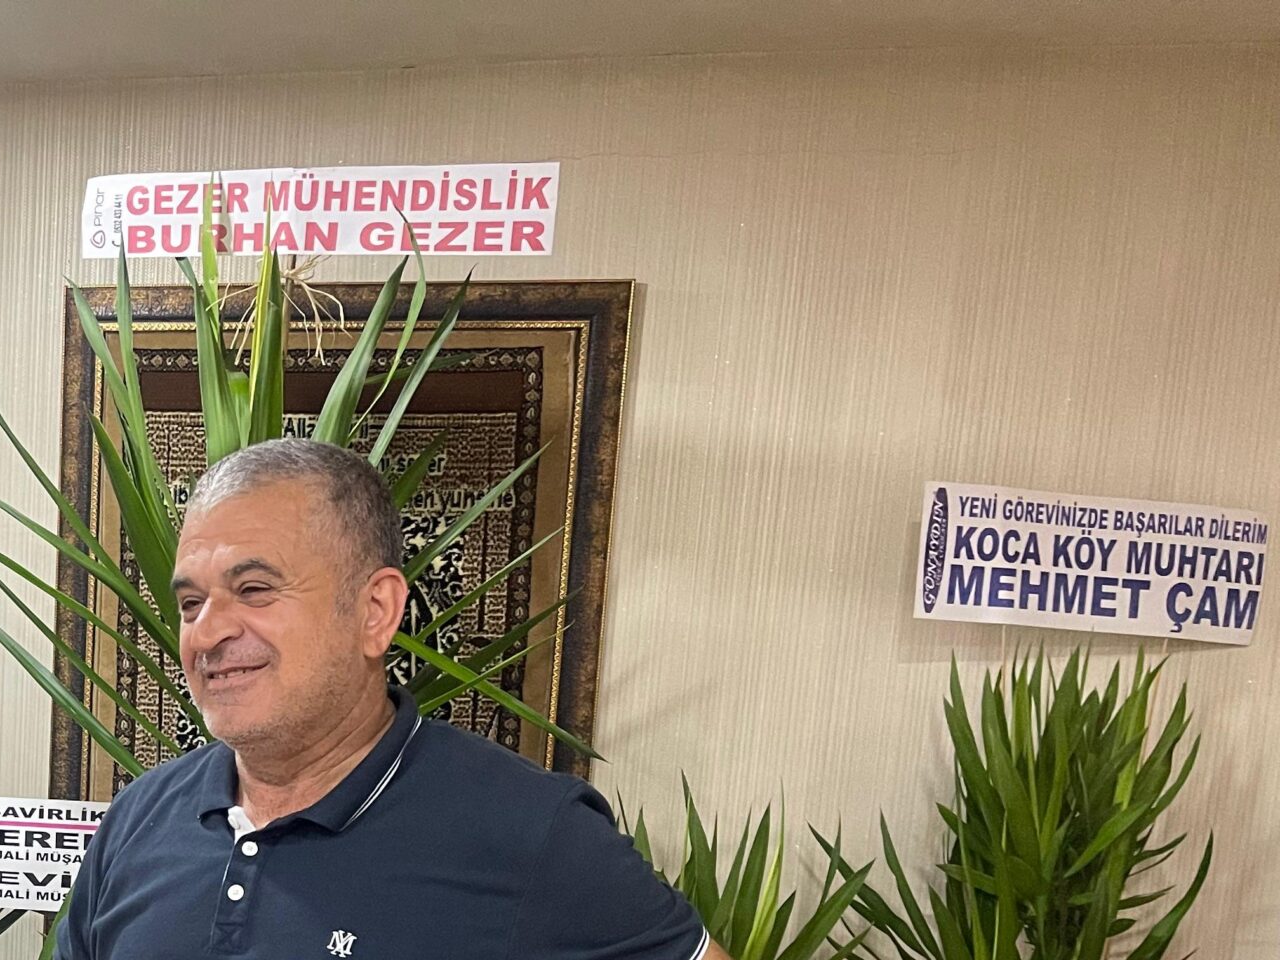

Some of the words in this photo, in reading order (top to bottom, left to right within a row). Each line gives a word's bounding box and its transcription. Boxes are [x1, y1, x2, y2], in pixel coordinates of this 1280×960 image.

[126, 182, 249, 215] GEZER
[263, 169, 552, 213] MÜHENDİSLİK
[127, 221, 339, 254] BURHAN
[360, 221, 546, 252] GEZER
[958, 493, 998, 518] YENİ
[1002, 496, 1109, 530] GÖREVİNİZDE
[1113, 510, 1205, 539] BAŞARILAR
[1209, 514, 1268, 545] DİLERİM
[953, 525, 1042, 566] KOCA
[1052, 529, 1118, 572] KÖY
[1126, 540, 1265, 586] MUHTARI
[946, 564, 1151, 619] MEHMET
[1166, 582, 1260, 633] ÇAM
